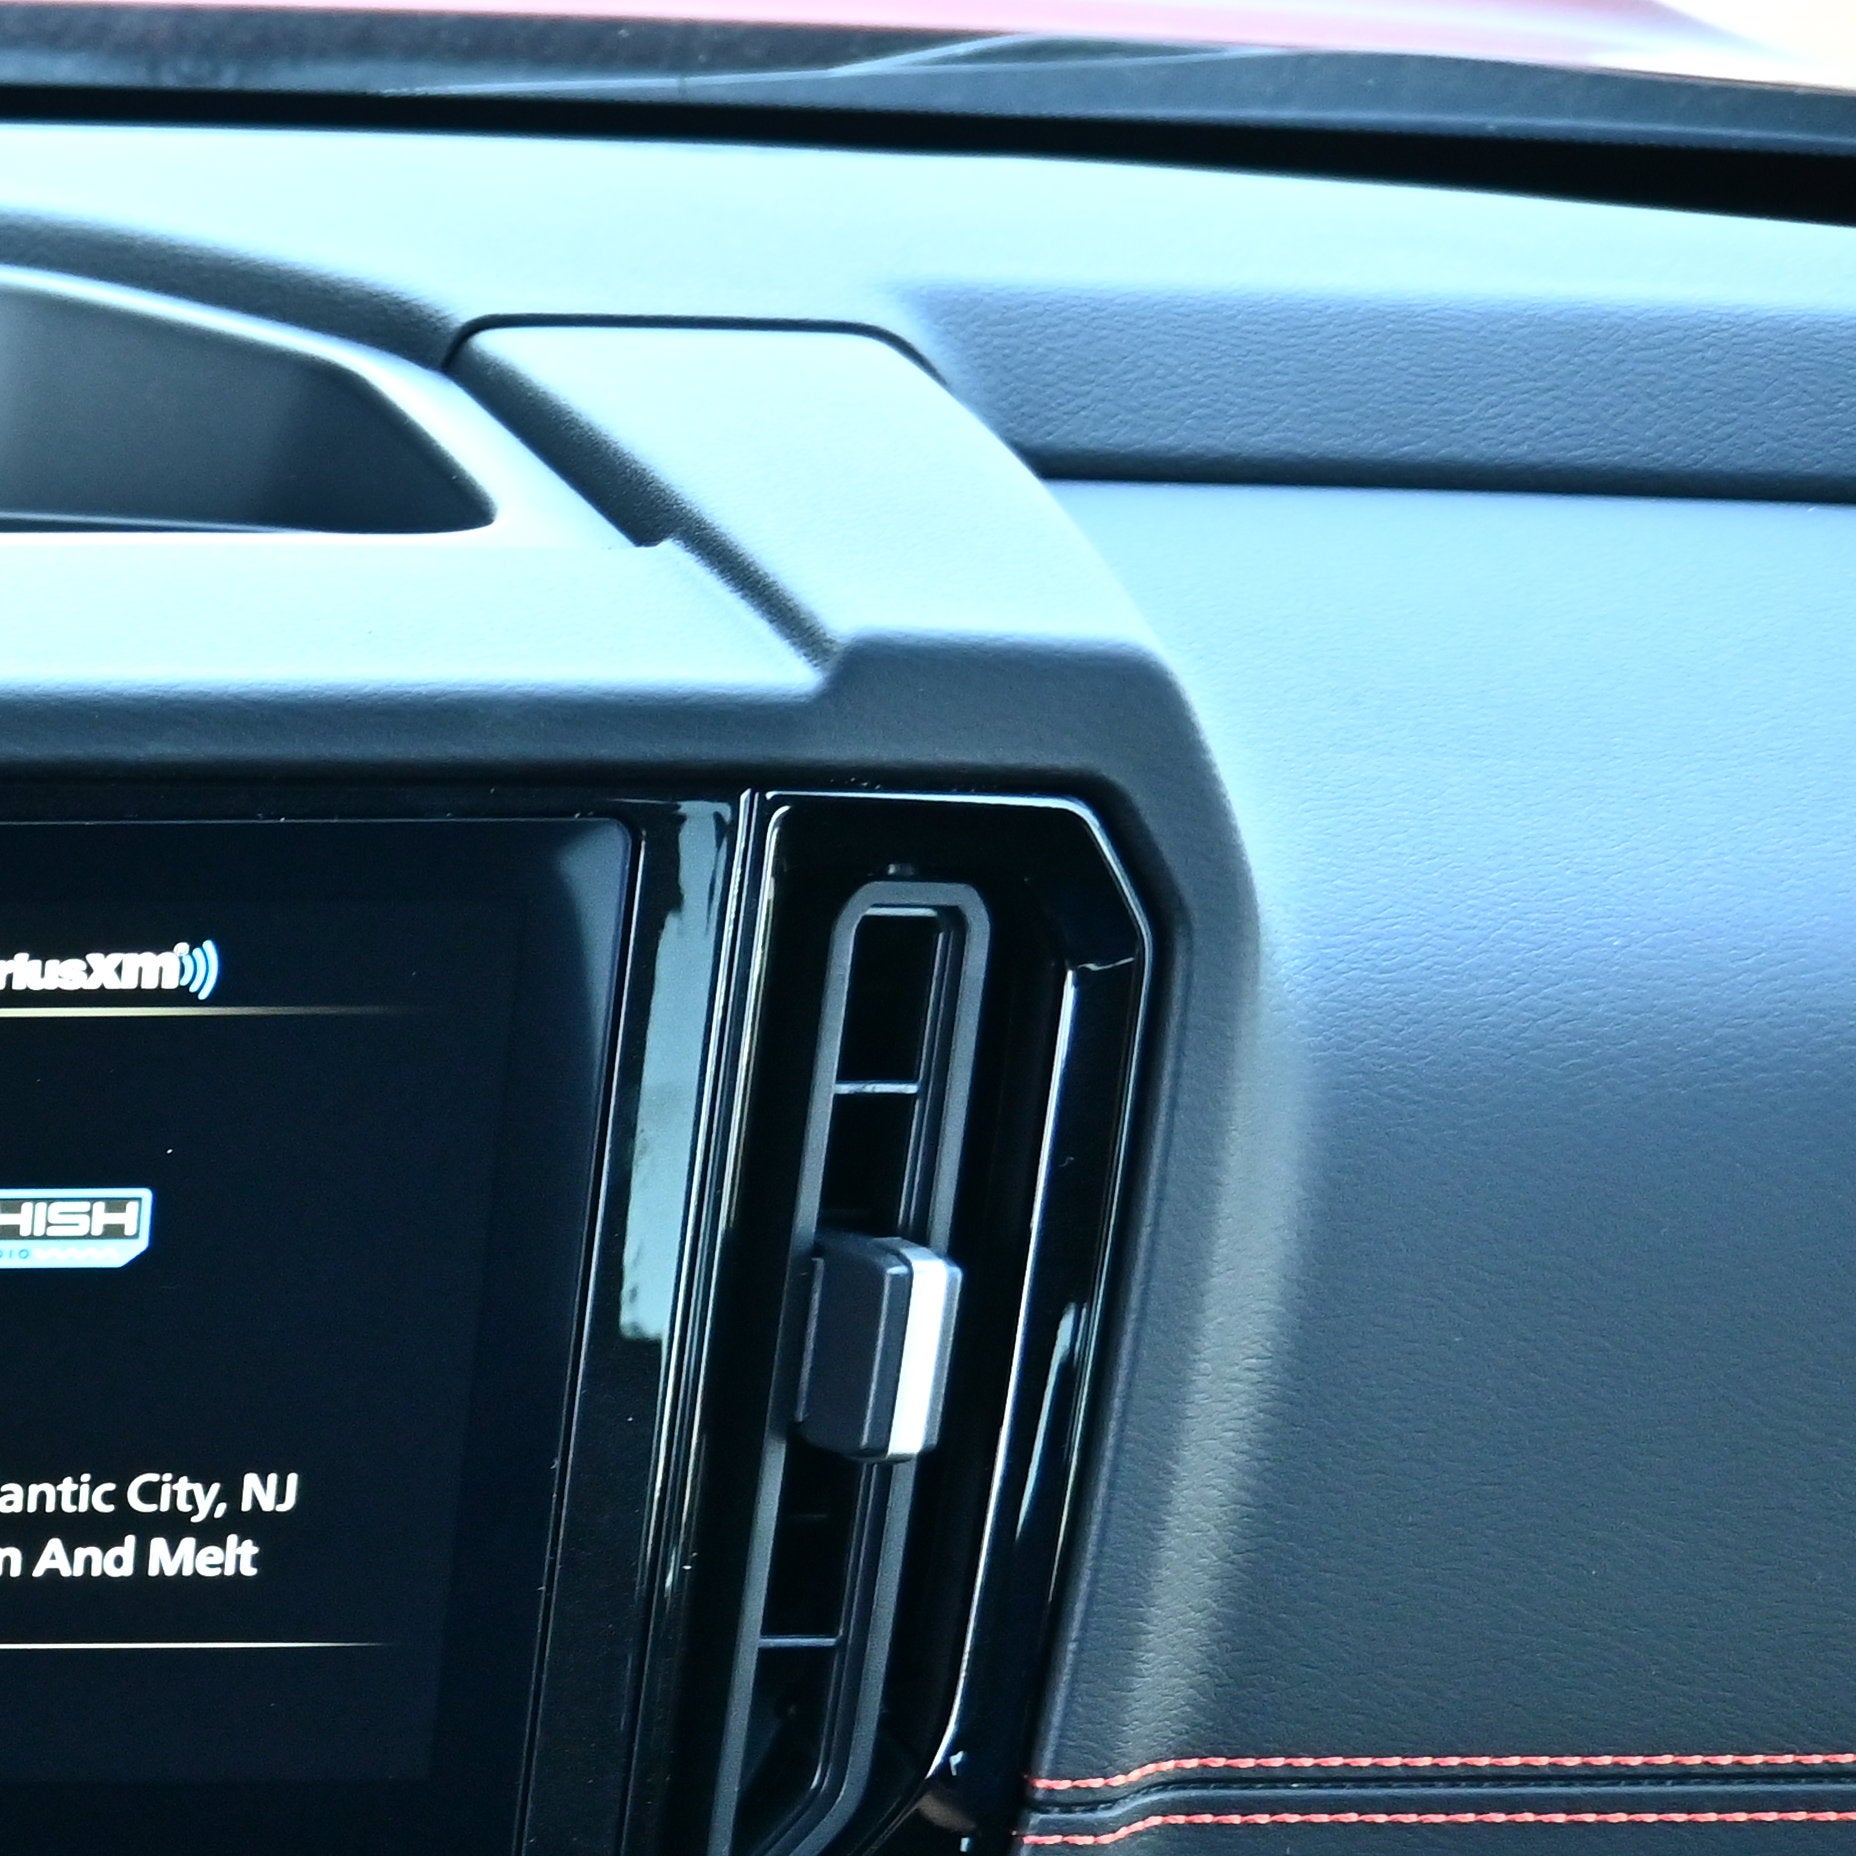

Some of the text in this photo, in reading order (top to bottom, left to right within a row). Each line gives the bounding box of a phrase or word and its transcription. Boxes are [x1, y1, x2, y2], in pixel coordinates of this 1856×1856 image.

[126, 1472, 227, 1523] City,
[241, 1472, 299, 1513] NJ
[32, 1533, 134, 1579] And
[147, 1533, 260, 1578] Melt
